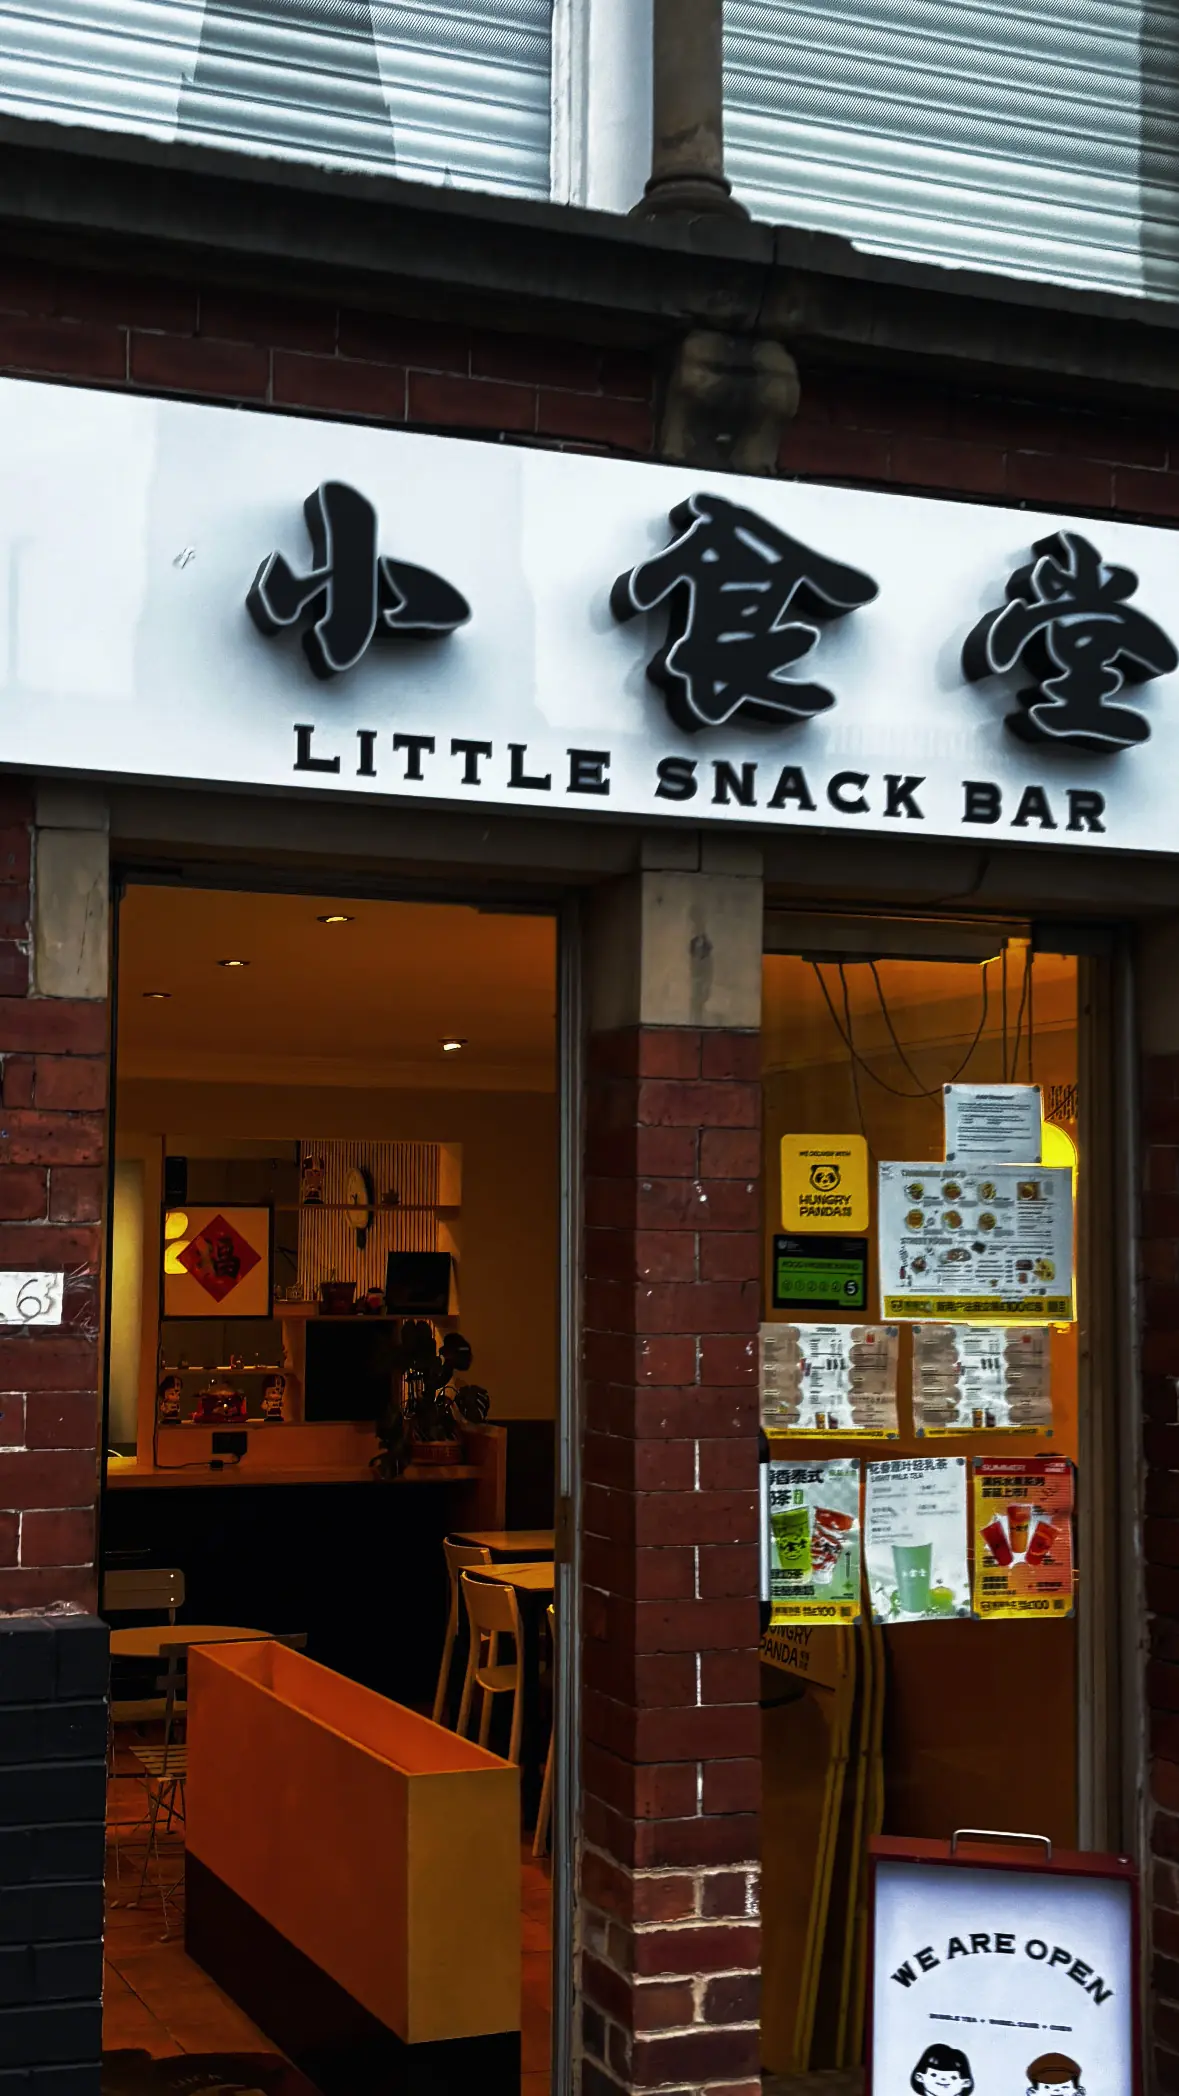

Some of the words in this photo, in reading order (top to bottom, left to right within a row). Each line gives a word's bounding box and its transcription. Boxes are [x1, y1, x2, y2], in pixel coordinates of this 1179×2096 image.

[246, 481, 1179, 755] 小食堂
[293, 723, 611, 796] LITTLE
[655, 757, 926, 820] SNACK
[961, 780, 1108, 834] BAR
[799, 1195, 852, 1205] HUNGRY
[846, 1281, 857, 1295] 5
[890, 1946, 941, 1988] WE
[947, 1932, 1016, 1960] ARE
[1024, 1939, 1114, 2006] OPEN
